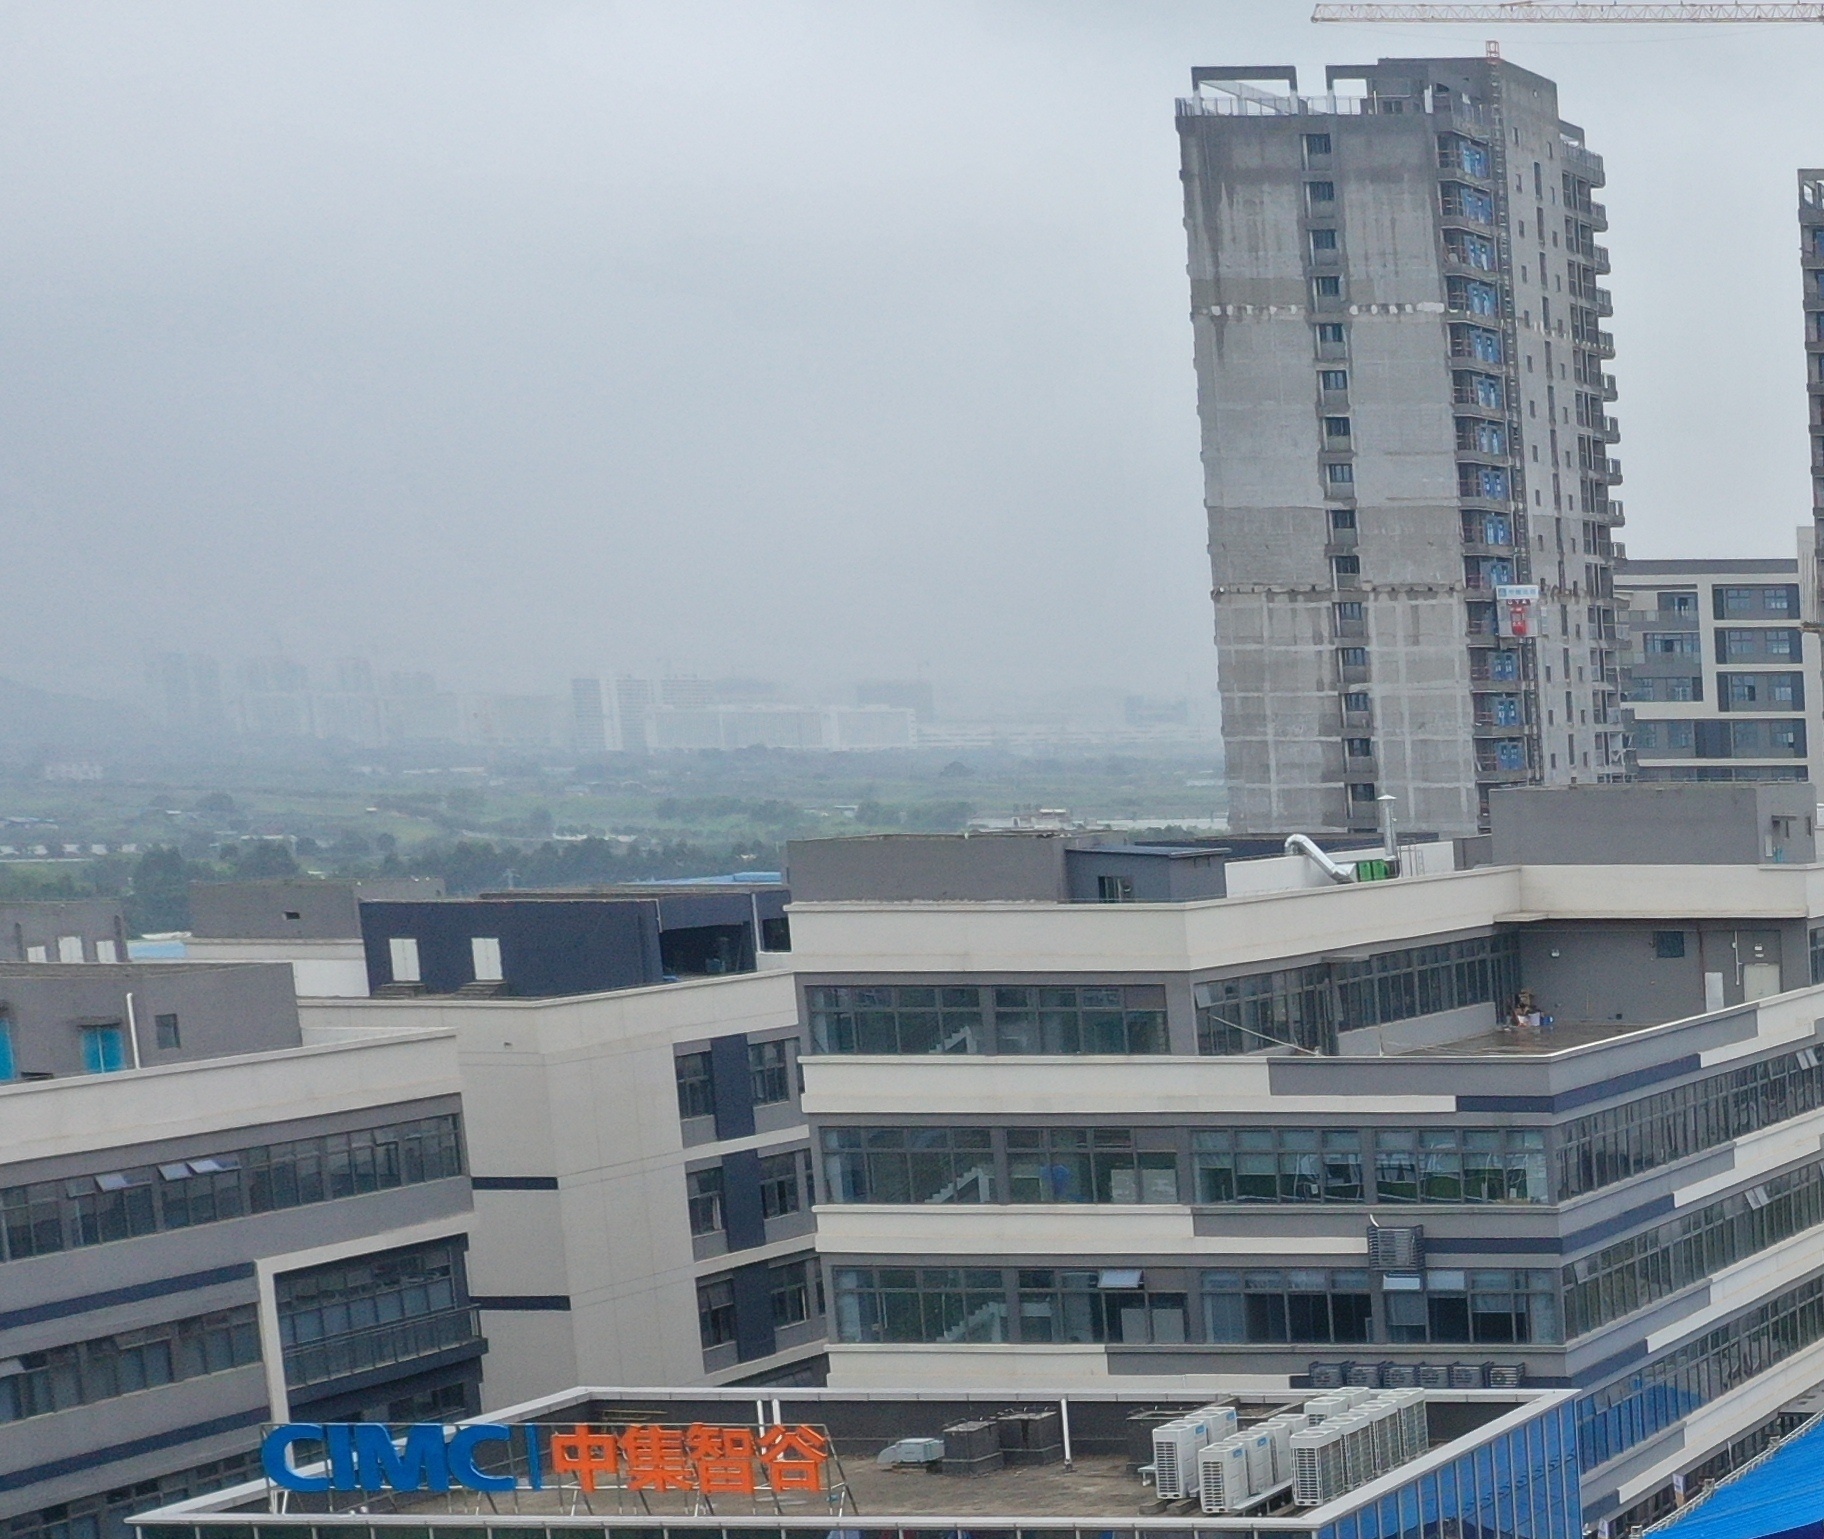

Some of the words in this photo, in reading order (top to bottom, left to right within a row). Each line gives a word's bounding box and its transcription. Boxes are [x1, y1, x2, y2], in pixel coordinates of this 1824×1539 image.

[261, 1423, 515, 1492] CIMC
[550, 1422, 828, 1493] 中集智谷
